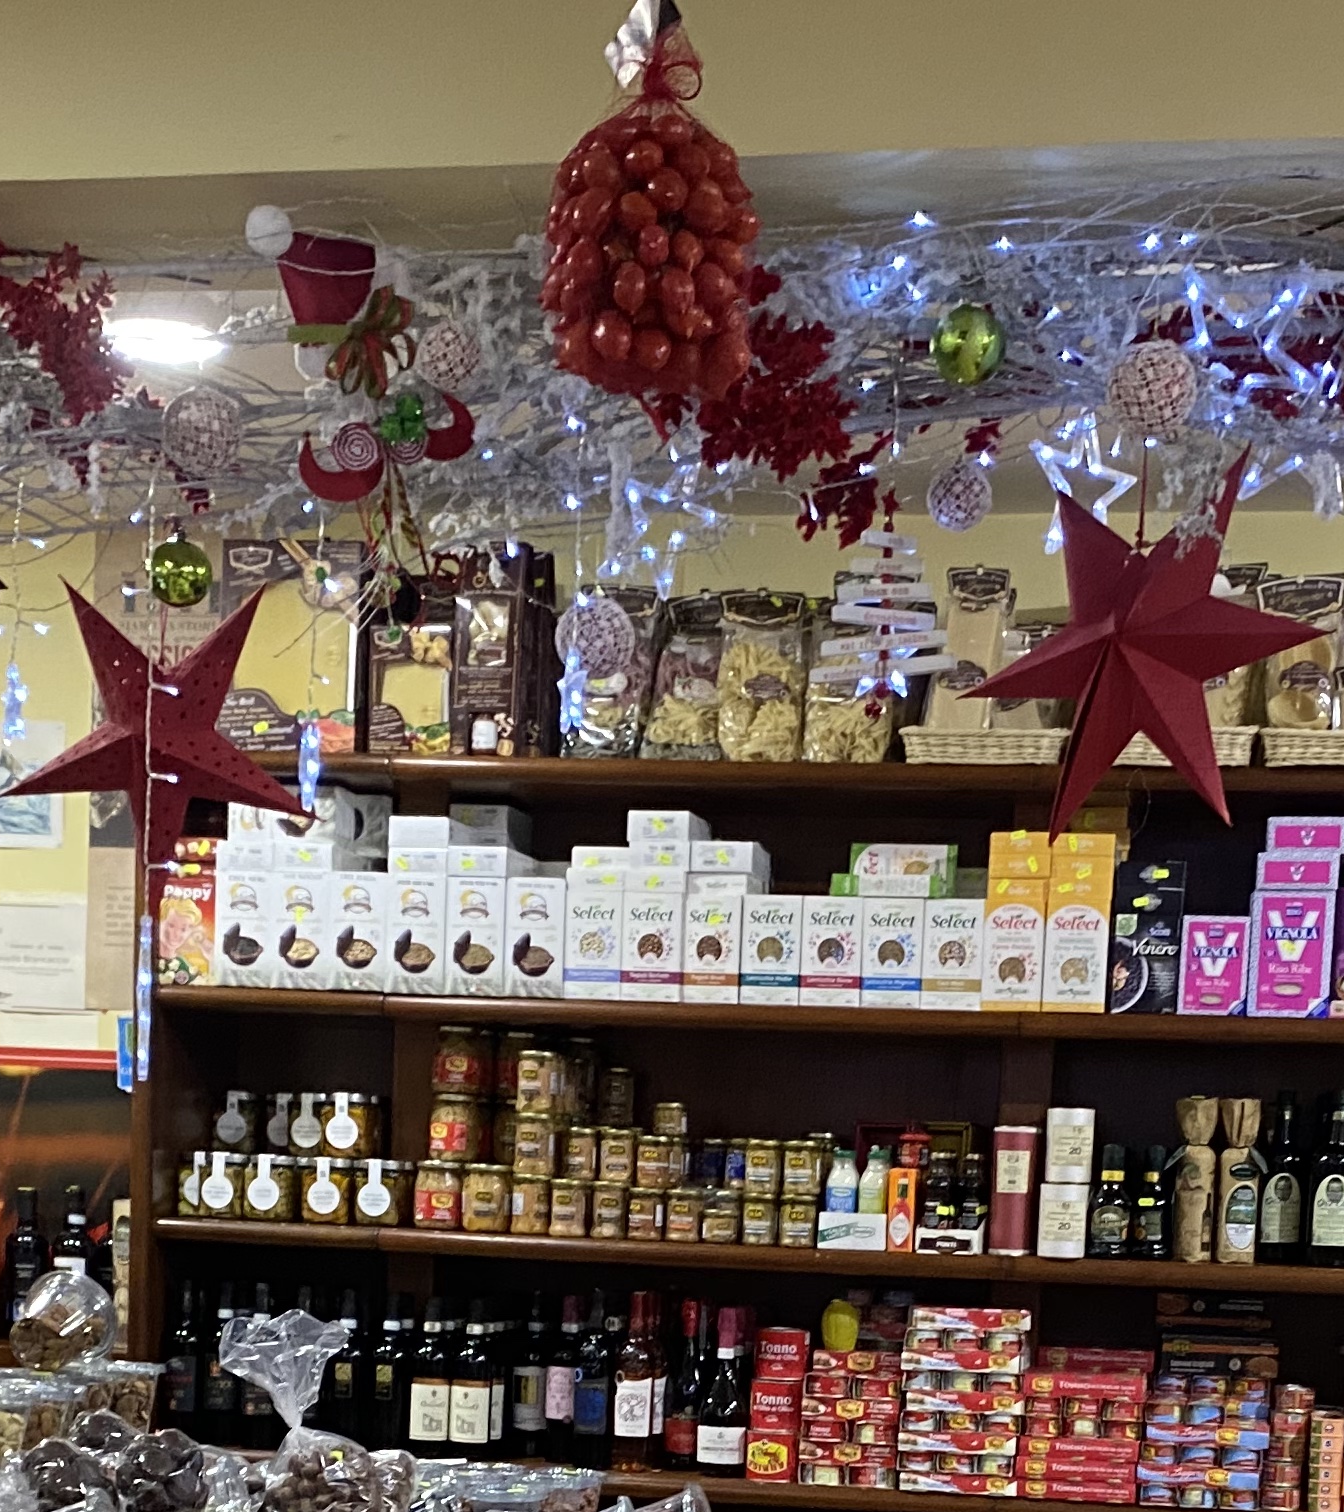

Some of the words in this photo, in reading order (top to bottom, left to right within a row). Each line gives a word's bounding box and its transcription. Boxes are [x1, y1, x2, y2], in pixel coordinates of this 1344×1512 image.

[572, 907, 615, 921] Select
[630, 908, 673, 922] Select
[750, 910, 794, 925] Select
[810, 911, 855, 926] Select
[871, 913, 915, 929] Select
[930, 914, 976, 929] Select
[992, 914, 1037, 931] Select
[1052, 916, 1100, 932] Select
[1266, 928, 1318, 941] VIGNOLA
[1193, 947, 1238, 958] VIGNOLA
[1069, 1146, 1081, 1155] 20
[1058, 1222, 1071, 1231] 20
[760, 1341, 797, 1355] Tonno
[755, 1394, 792, 1406] Tonno
